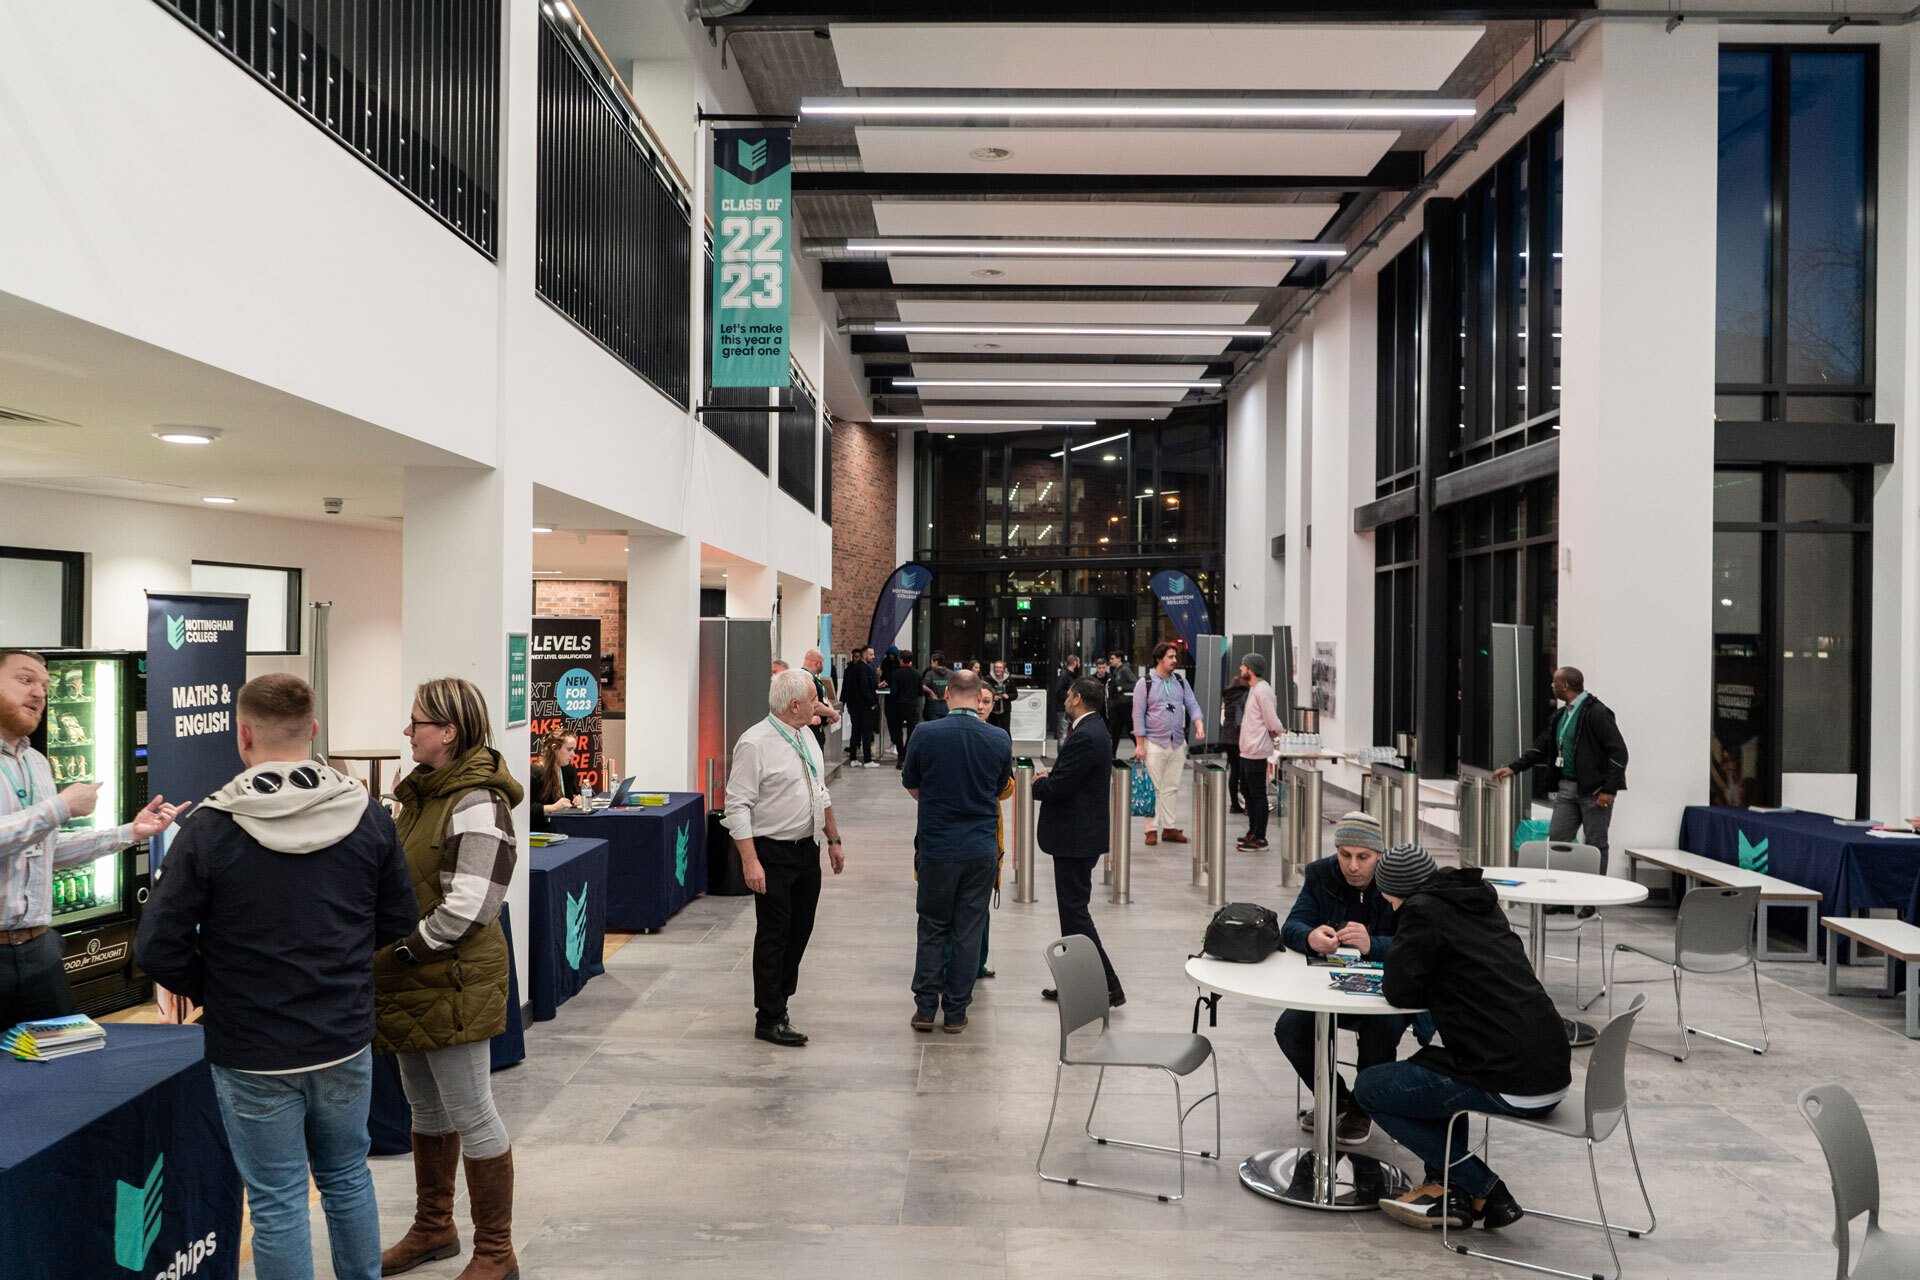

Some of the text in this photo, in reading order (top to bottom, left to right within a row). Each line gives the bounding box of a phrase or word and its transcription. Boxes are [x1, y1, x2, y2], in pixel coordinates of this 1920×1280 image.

[721, 199, 783, 211] CLASS OF
[721, 216, 783, 262] 22
[720, 263, 783, 308] 23
[720, 324, 783, 334] Let's make
[720, 335, 782, 347] this year a
[722, 346, 781, 358] great one
[184, 620, 234, 631] NOTTINGHAM
[185, 632, 218, 643] COLLEGE
[531, 635, 592, 651] LEVELS
[565, 676, 589, 686] NEW
[172, 683, 231, 709] MATHS &
[565, 688, 587, 699] FOR
[565, 700, 592, 711] 2023
[175, 711, 230, 738] ENGLISH
[577, 770, 598, 787] TO
[64, 960, 80, 970] OOD
[91, 948, 122, 962] THOUGHT
